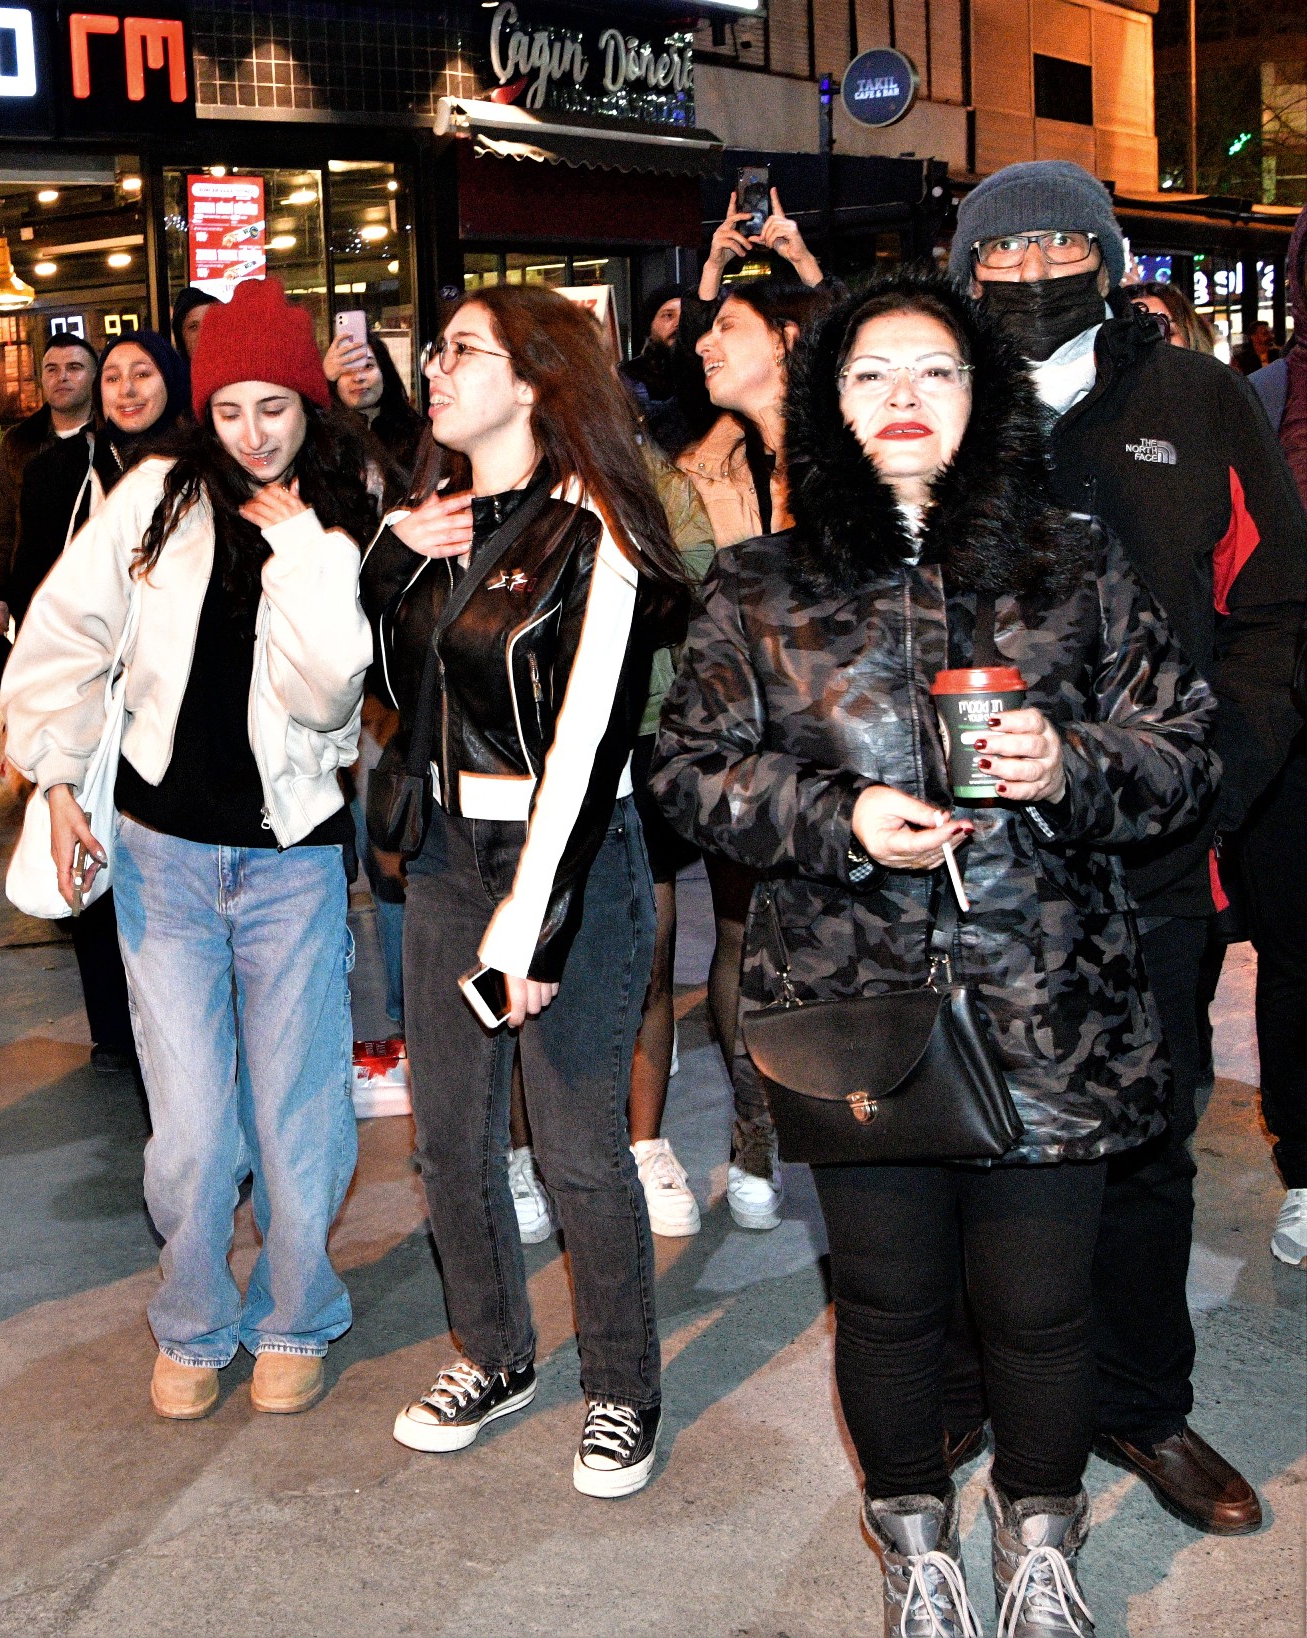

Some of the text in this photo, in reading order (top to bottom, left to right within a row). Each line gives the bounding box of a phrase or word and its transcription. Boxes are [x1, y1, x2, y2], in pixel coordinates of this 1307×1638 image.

[1140, 438, 1157, 447] THE
[1125, 444, 1157, 453] NORTH
[1134, 453, 1157, 462] FACE
